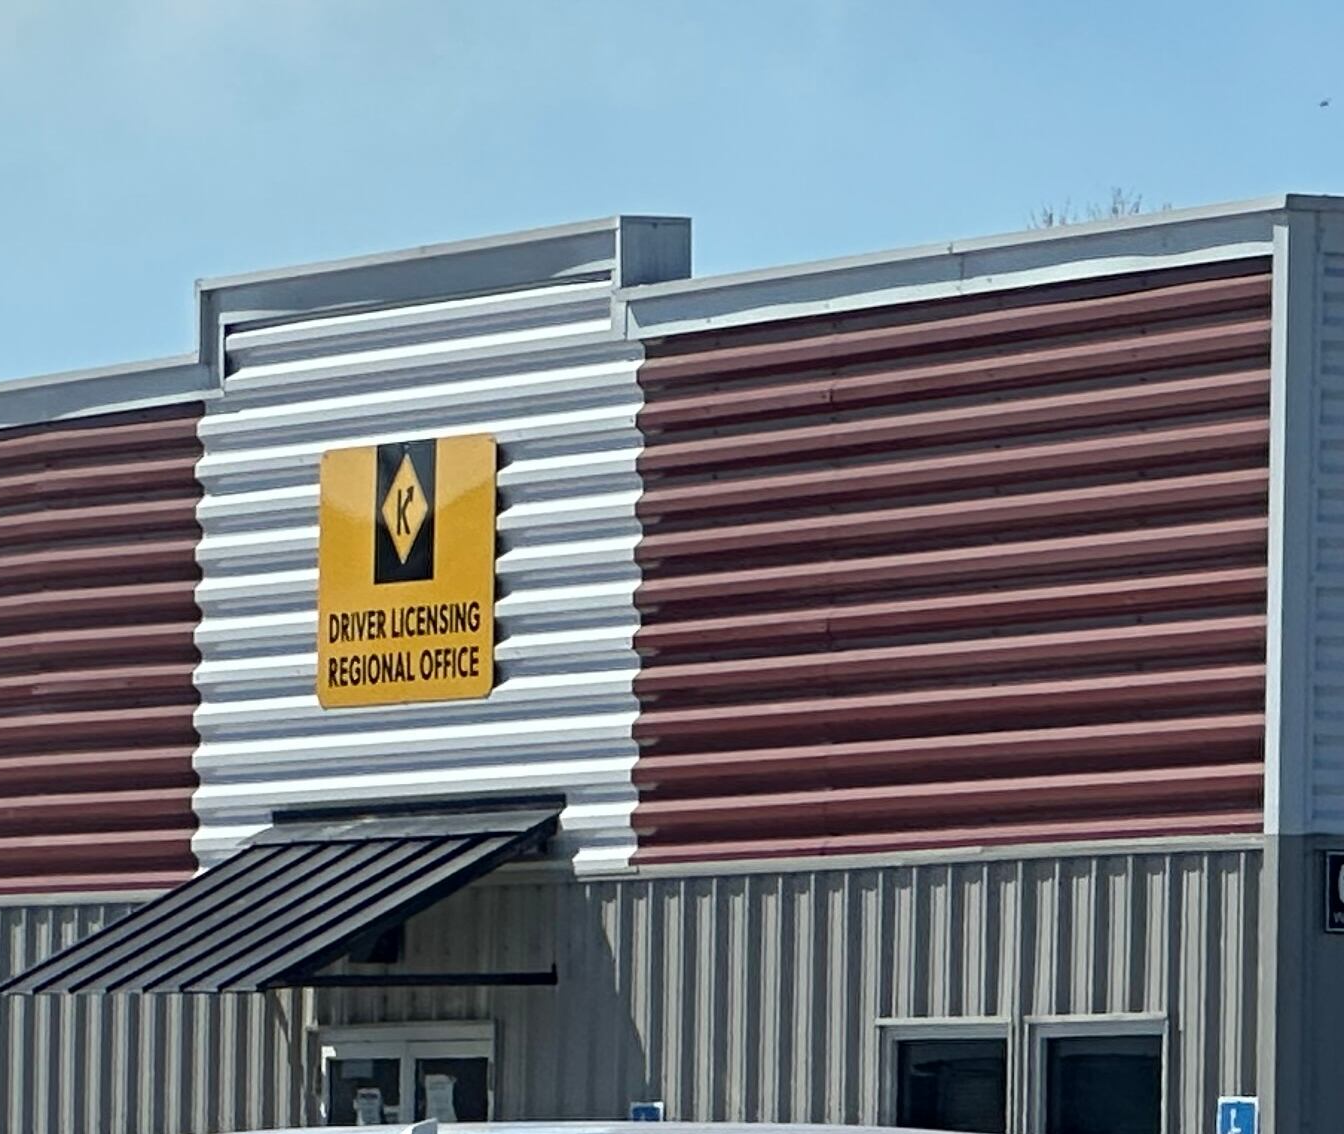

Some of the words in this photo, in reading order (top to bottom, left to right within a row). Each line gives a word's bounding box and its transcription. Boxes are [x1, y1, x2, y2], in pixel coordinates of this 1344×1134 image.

[329, 610, 386, 643] DRIVER
[391, 601, 480, 638] LICENSING
[328, 651, 416, 687] REGIONAL
[420, 646, 480, 680] OFFICE
